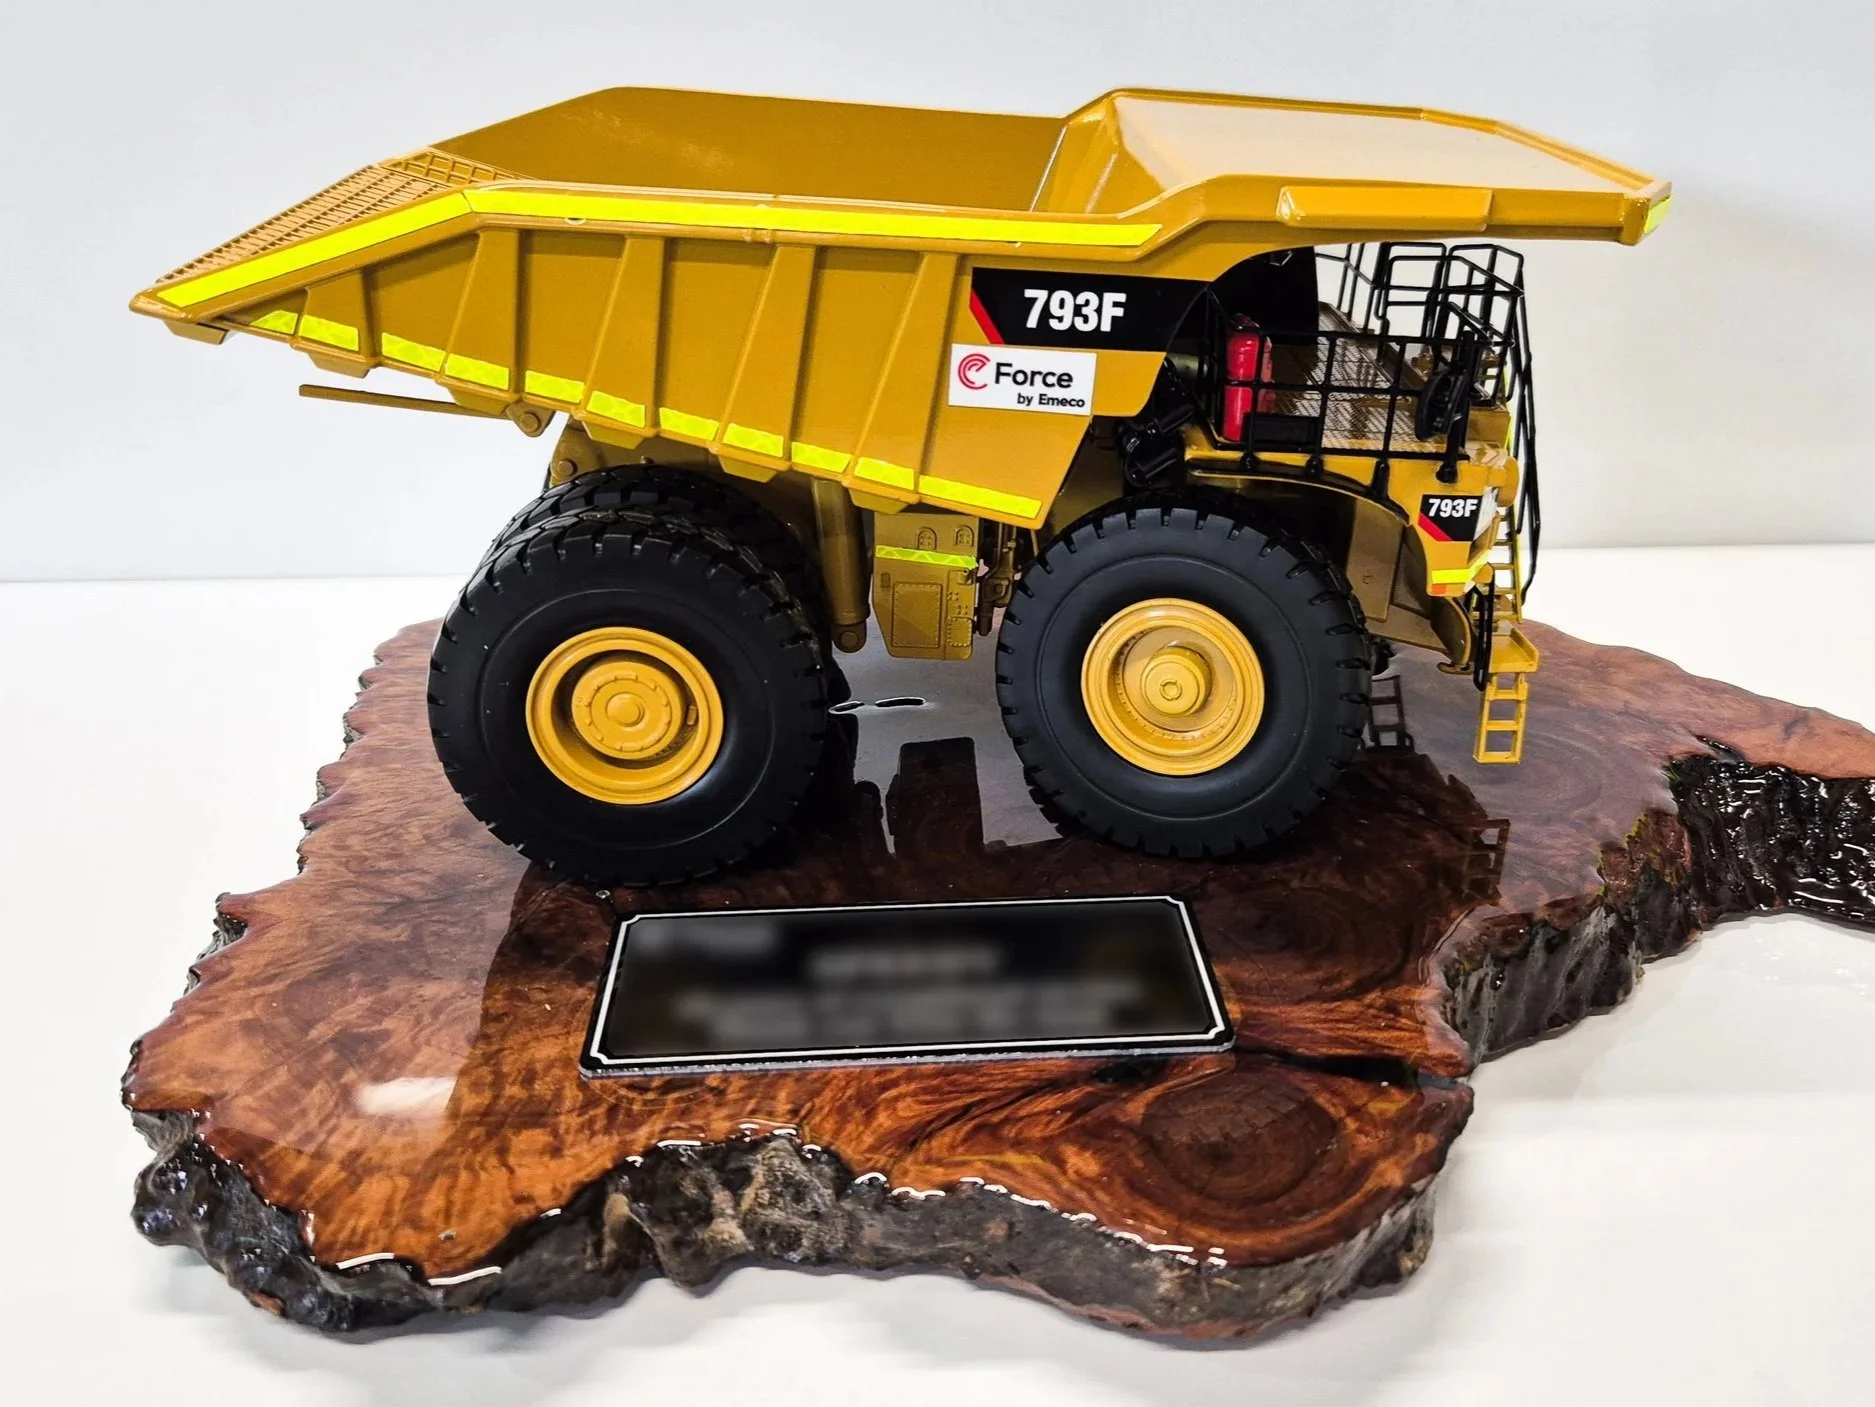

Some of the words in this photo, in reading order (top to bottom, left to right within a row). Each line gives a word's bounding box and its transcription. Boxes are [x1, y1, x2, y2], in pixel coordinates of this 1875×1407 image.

[1023, 289, 1127, 332] 793F
[995, 362, 1074, 388] Force
[1017, 393, 1033, 406] by
[1038, 394, 1086, 408] Emeco
[1428, 498, 1478, 518] 793F
